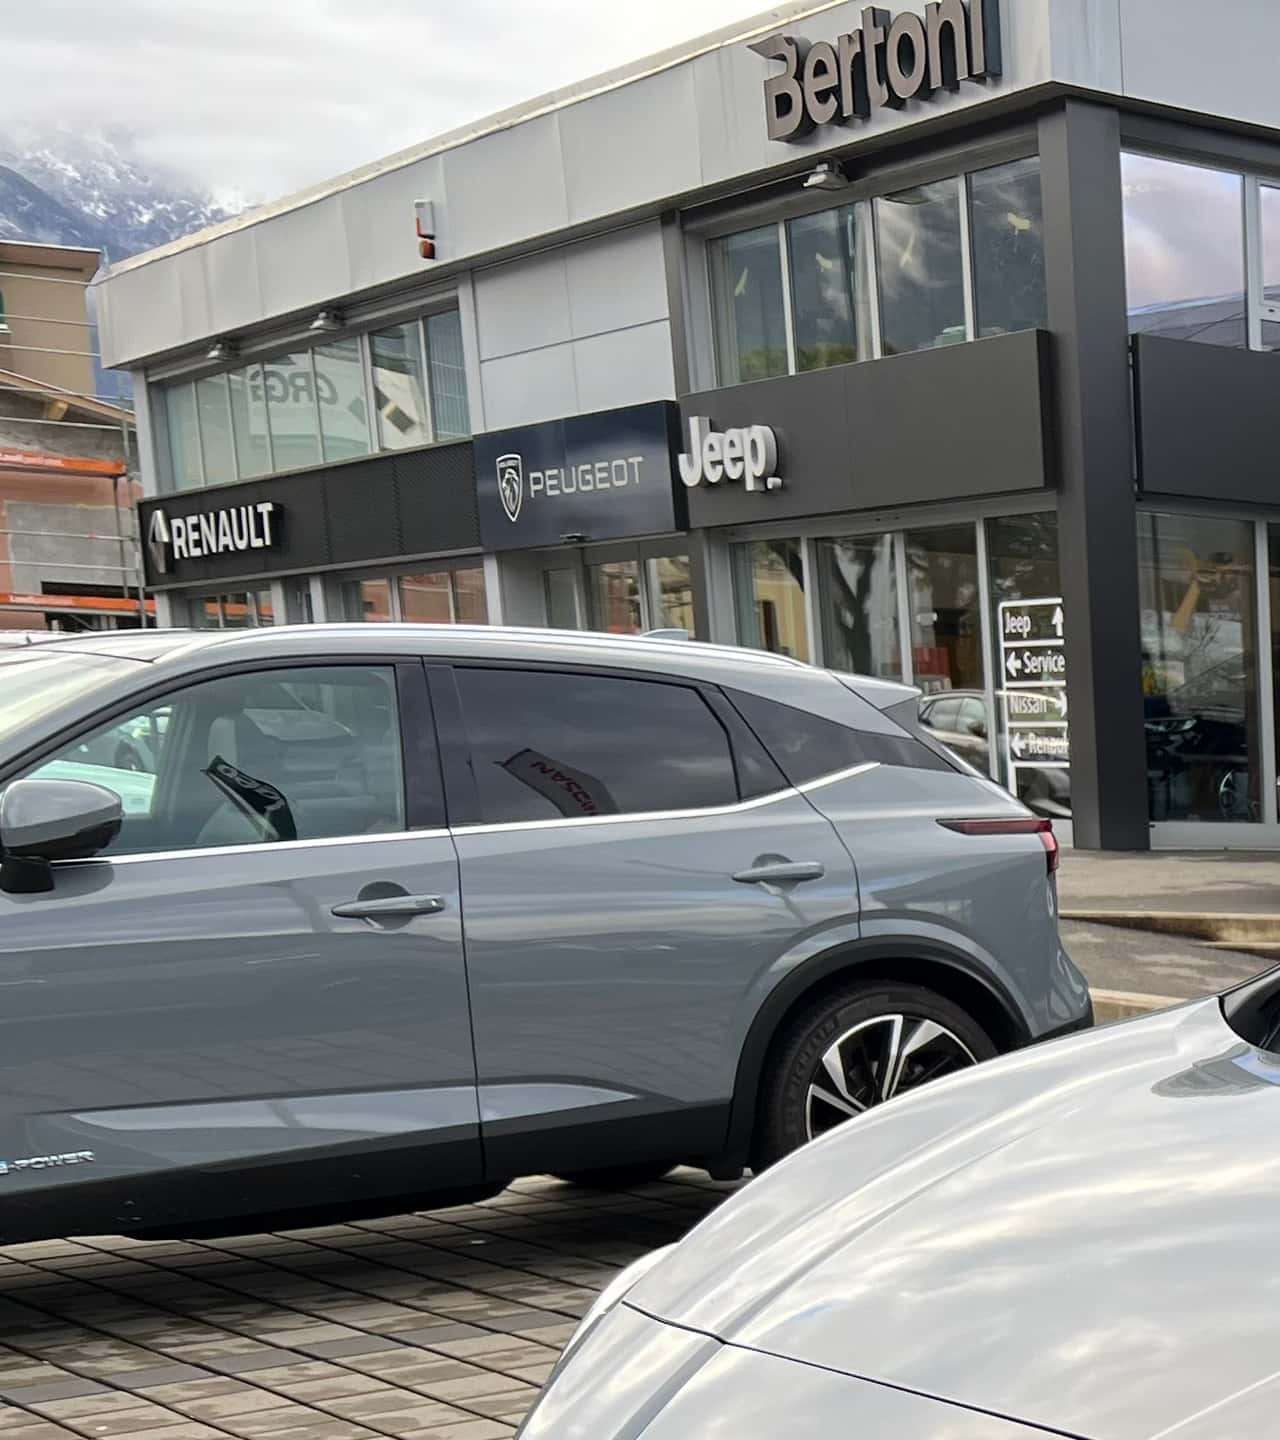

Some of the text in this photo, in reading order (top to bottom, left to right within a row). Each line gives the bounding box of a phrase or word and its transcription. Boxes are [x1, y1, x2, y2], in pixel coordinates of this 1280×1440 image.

[747, 0, 1000, 141] Bertoni
[678, 416, 782, 492] Jeep
[529, 456, 644, 498] PEUGEOT
[170, 502, 273, 560] RENAULT
[1004, 611, 1031, 639] Jeep
[1022, 650, 1066, 673] Service
[1009, 694, 1048, 714] Nissan
